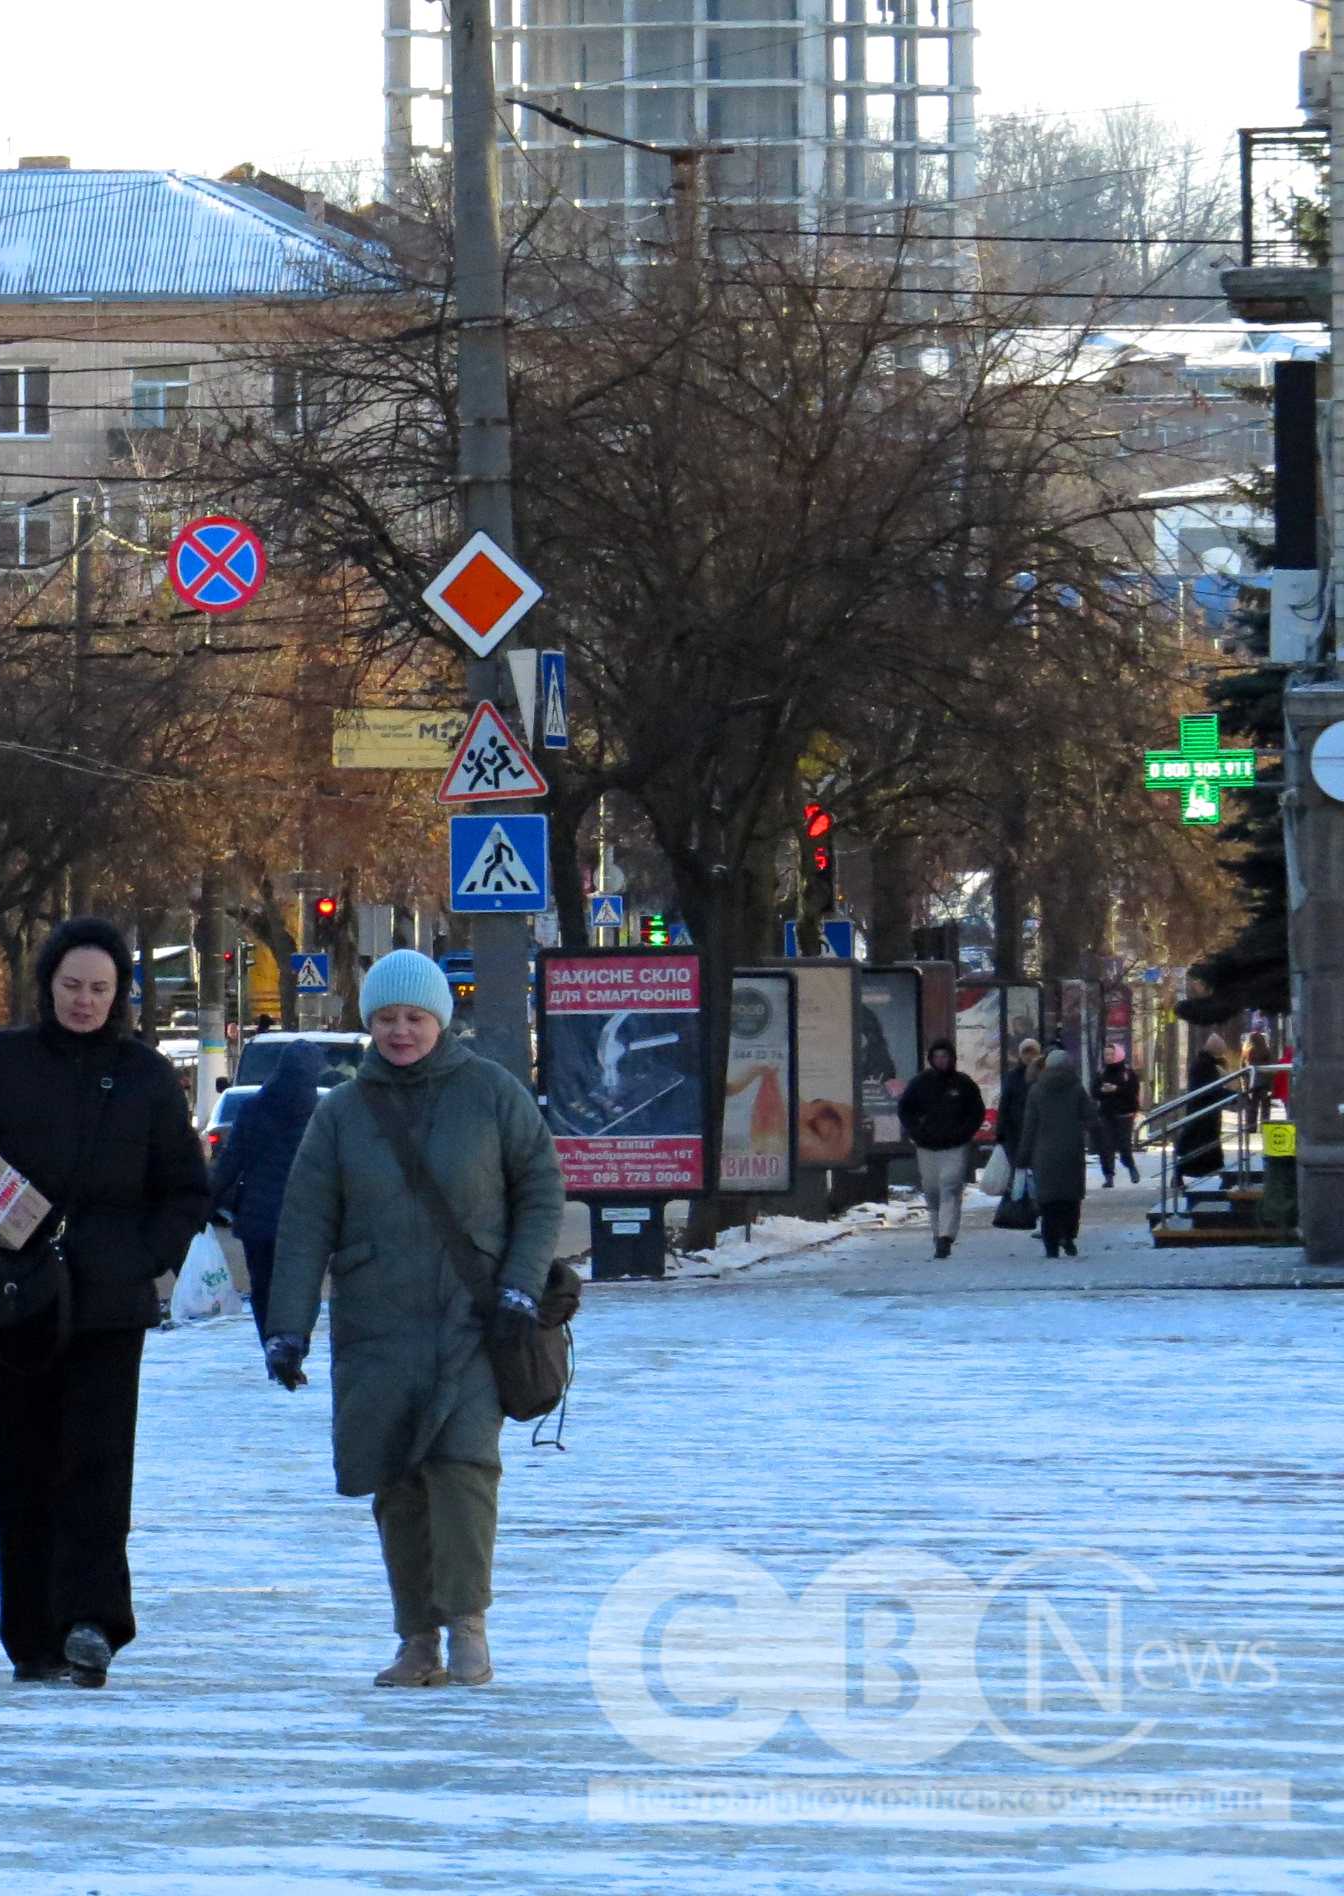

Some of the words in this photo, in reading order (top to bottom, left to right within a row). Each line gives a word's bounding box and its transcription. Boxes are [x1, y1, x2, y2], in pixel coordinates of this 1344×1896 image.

[1163, 763, 1190, 777] 800
[1194, 762, 1221, 777] 505
[551, 968, 634, 985] ЗАХИСНЕ
[639, 967, 691, 984] СКЛО
[550, 990, 581, 1004] ДЛЯ
[586, 988, 692, 1003] СМАРТФОНІВ
